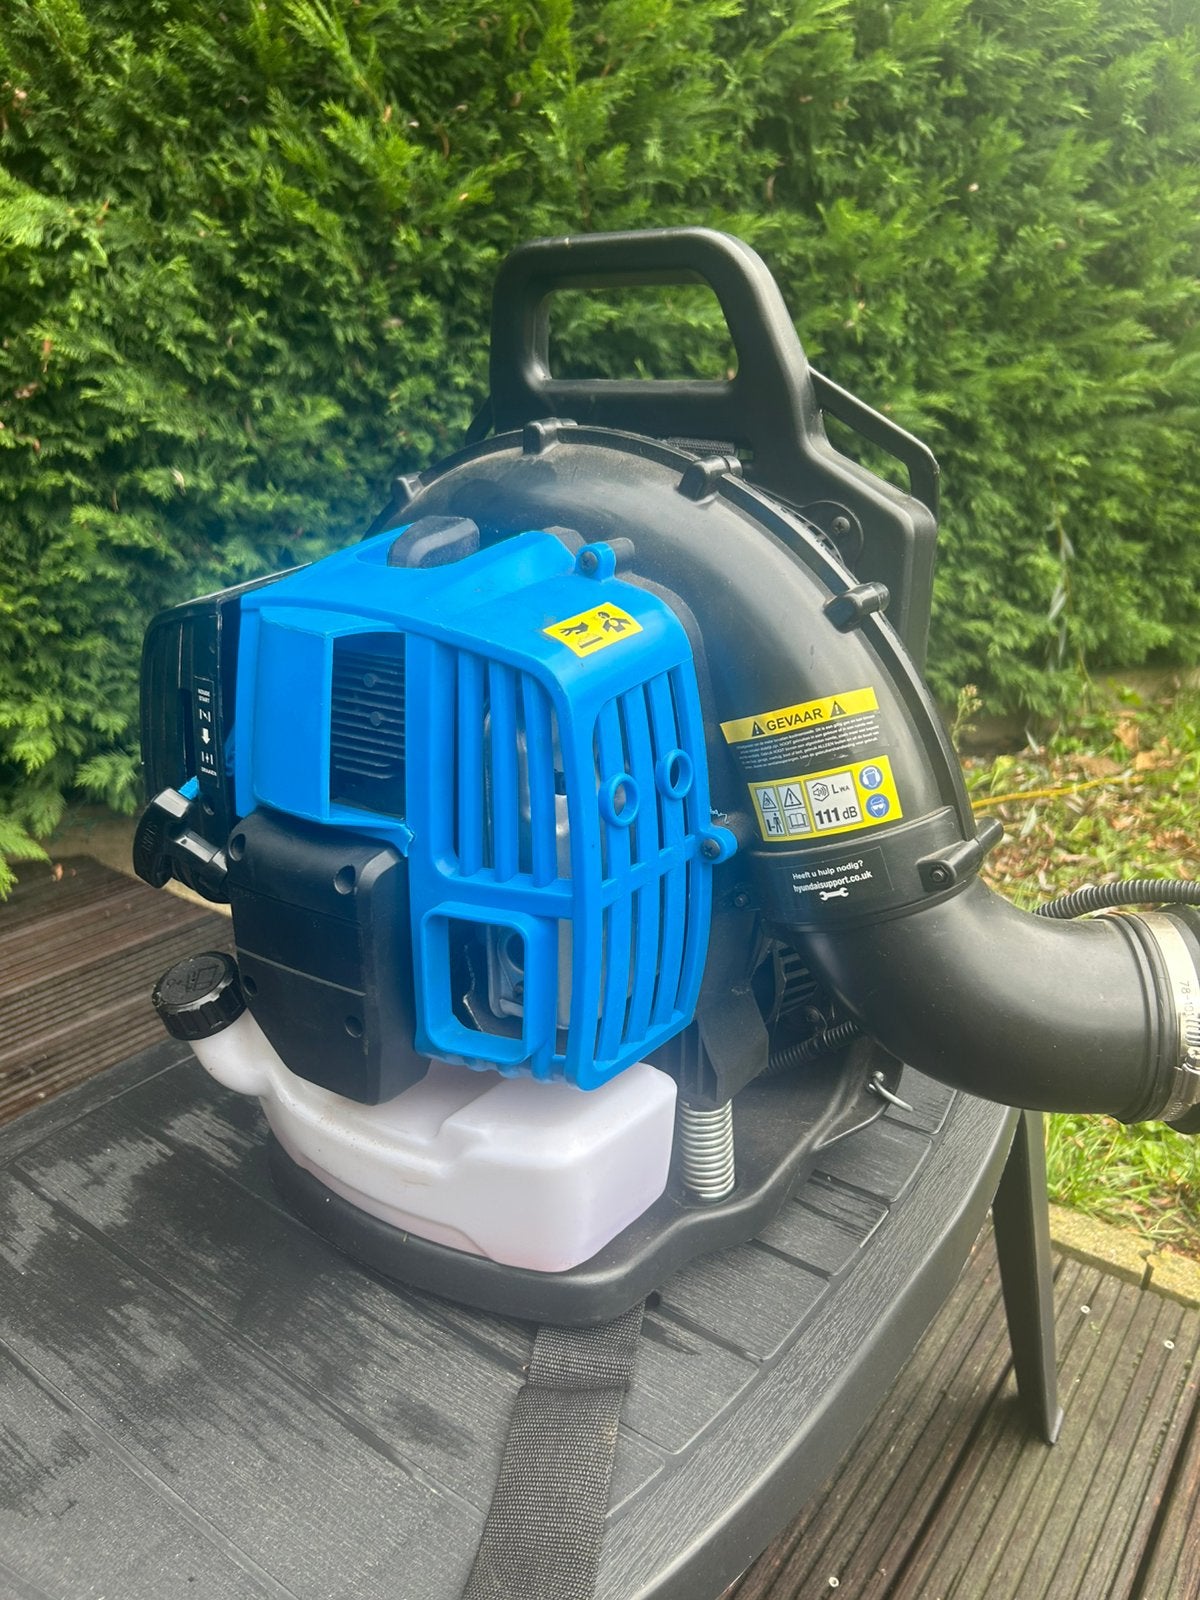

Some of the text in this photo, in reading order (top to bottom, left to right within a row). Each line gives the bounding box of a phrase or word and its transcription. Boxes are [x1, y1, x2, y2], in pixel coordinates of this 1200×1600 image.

[766, 708, 823, 731] GEVAAR
[815, 806, 858, 825] 111 dB
[792, 871, 811, 880] Heeft
[817, 867, 835, 876] hulp
[836, 859, 864, 873] nodig?
[793, 870, 873, 893] hyundaisupport.co.uk
